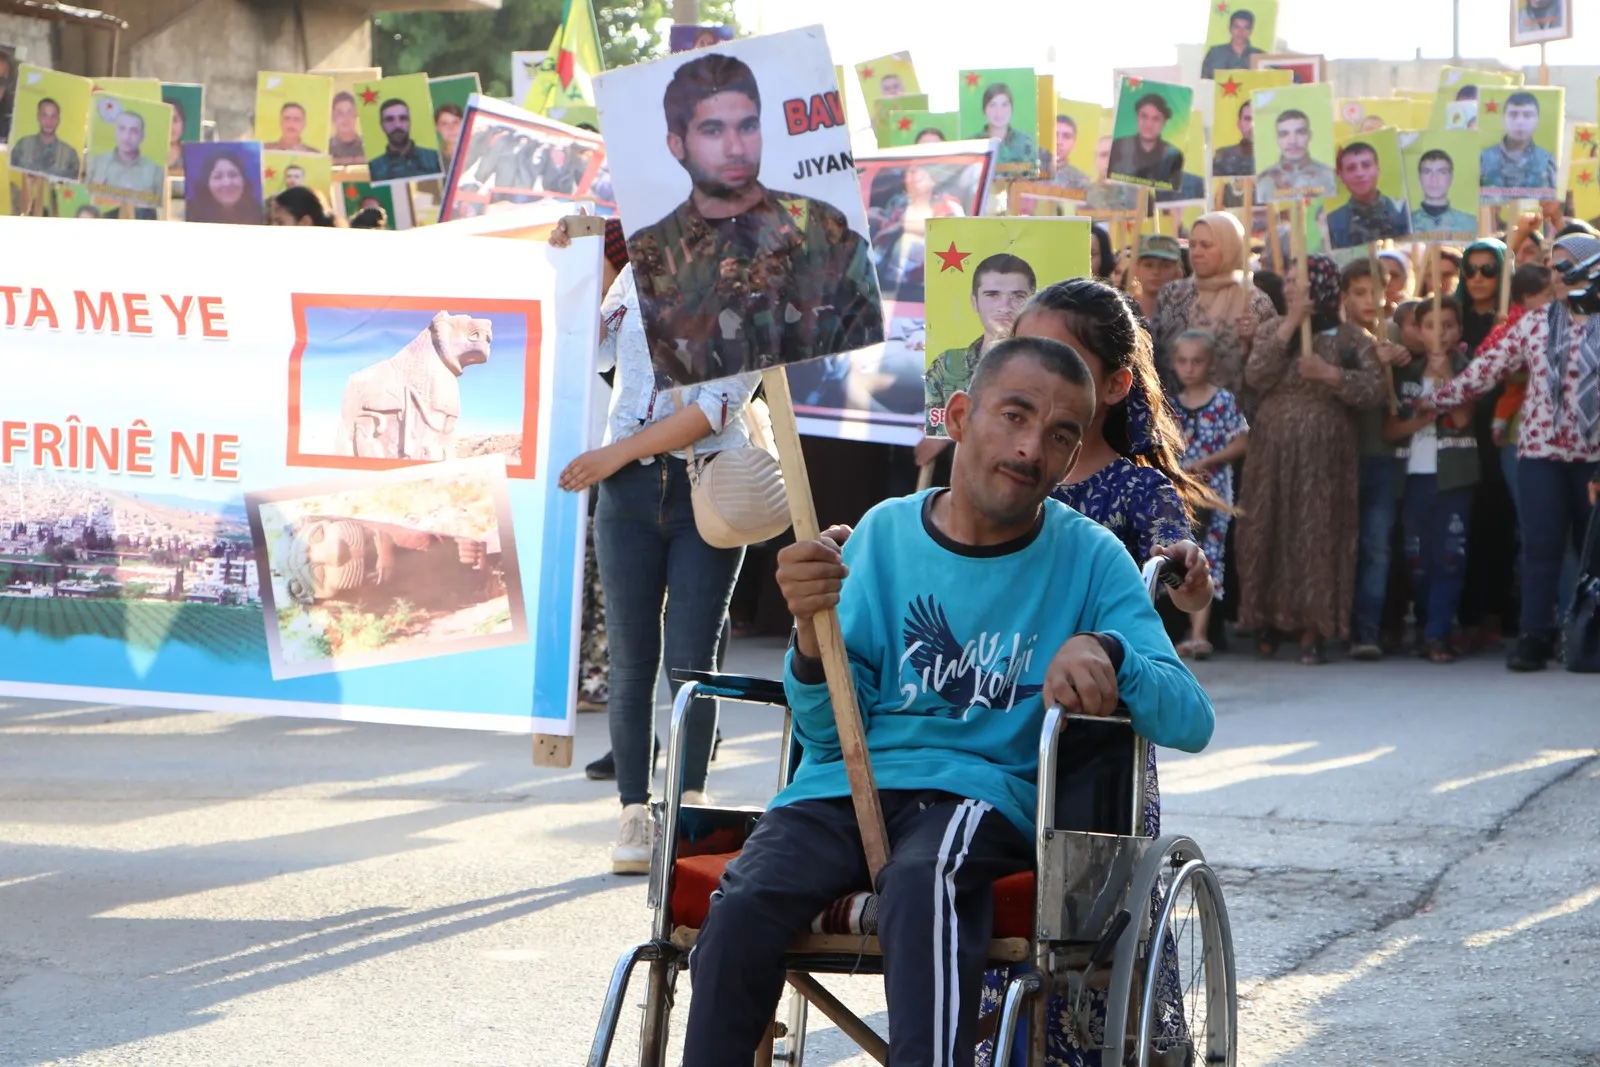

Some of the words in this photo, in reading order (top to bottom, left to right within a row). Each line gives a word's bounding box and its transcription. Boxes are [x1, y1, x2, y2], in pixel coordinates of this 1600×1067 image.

[0, 285, 59, 329] TA
[73, 290, 153, 334] ME
[160, 294, 229, 338] YE
[2, 414, 153, 474] FRÎNÊ
[170, 431, 239, 478] NE
